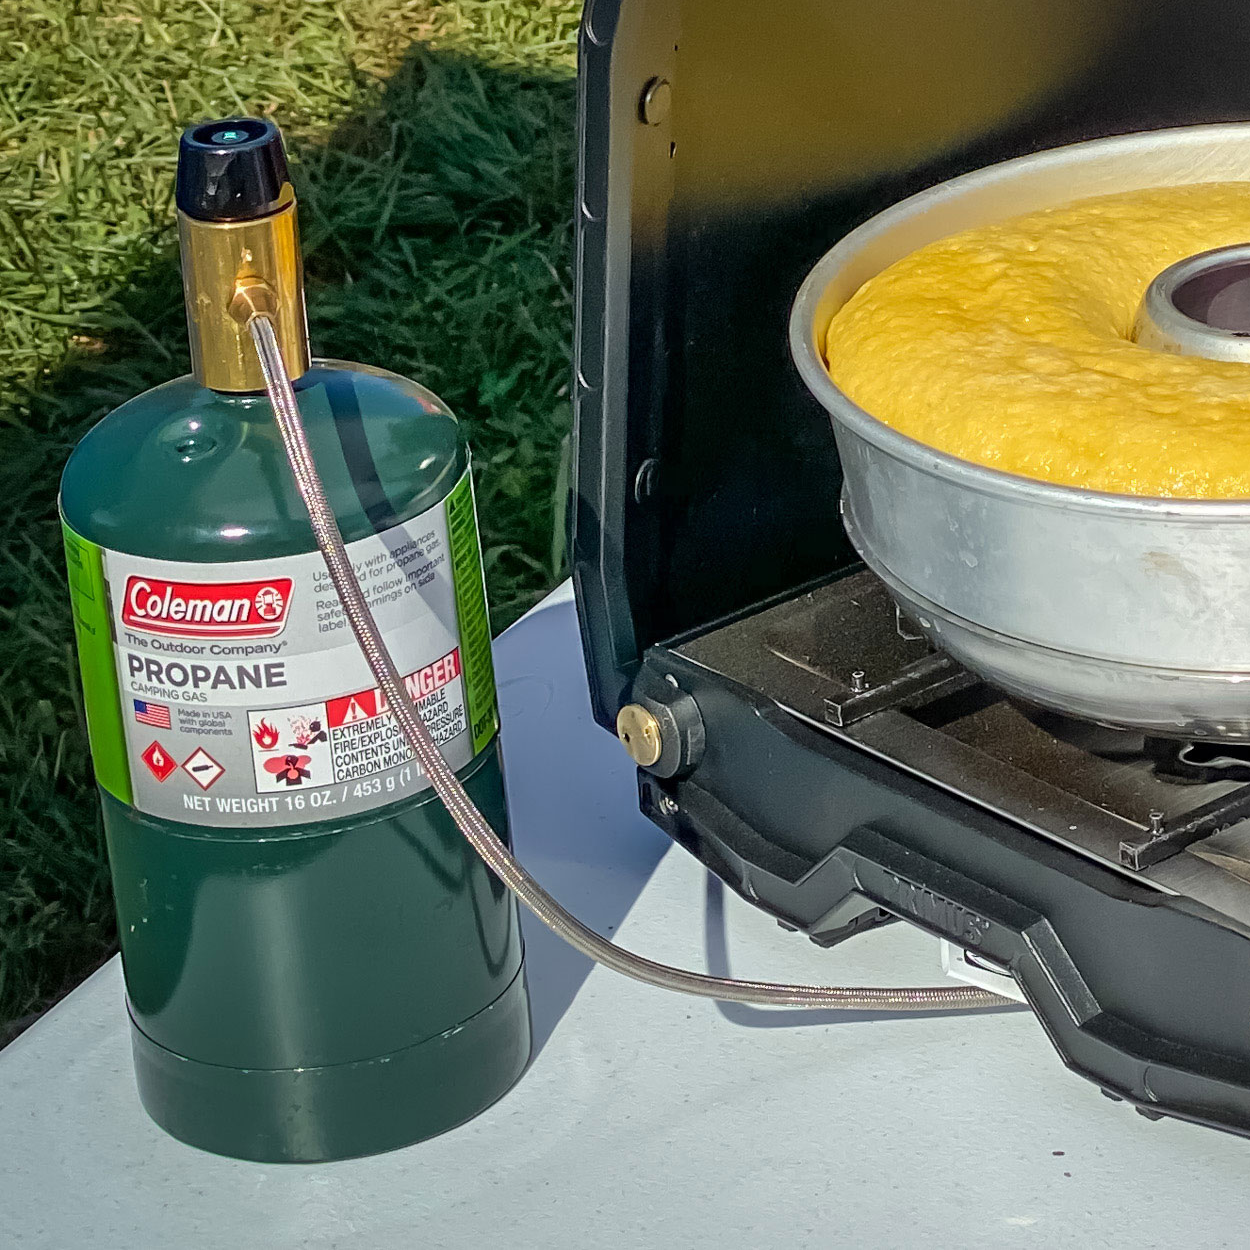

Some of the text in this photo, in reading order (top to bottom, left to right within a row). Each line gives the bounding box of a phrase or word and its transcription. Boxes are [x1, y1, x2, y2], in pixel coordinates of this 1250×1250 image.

[365, 553, 387, 568] with
[390, 530, 436, 559] appliances
[369, 567, 384, 580] for
[386, 550, 425, 572] propane
[316, 598, 341, 610] Rea
[372, 577, 403, 595] follow
[405, 554, 445, 582] important
[317, 609, 348, 622] safe
[366, 589, 403, 608] arnings
[404, 582, 416, 594] on
[418, 571, 436, 587] side
[130, 581, 252, 623] Coleman
[124, 633, 149, 648] The
[151, 638, 206, 655] Outdoor
[127, 653, 288, 690] PROPANE
[374, 653, 458, 714] DNGER
[131, 681, 208, 703] CAMPING GAS
[178, 708, 232, 719] Made in USA
[179, 717, 226, 728] with global
[332, 712, 392, 741] EXTREMELY
[334, 725, 400, 754] FIRE/EXPLOS
[423, 701, 449, 722] AZARD
[180, 726, 233, 737] components
[335, 744, 391, 768] CONTENTS
[336, 760, 382, 781] CARBON
[384, 747, 415, 768] MONO
[183, 794, 211, 811] NET
[218, 798, 279, 813] WEIGHT
[285, 796, 305, 810] 16
[310, 792, 337, 807] OZ.
[341, 786, 348, 802] /
[353, 782, 381, 799] 453
[386, 776, 396, 792] g
[400, 766, 411, 787] (1
